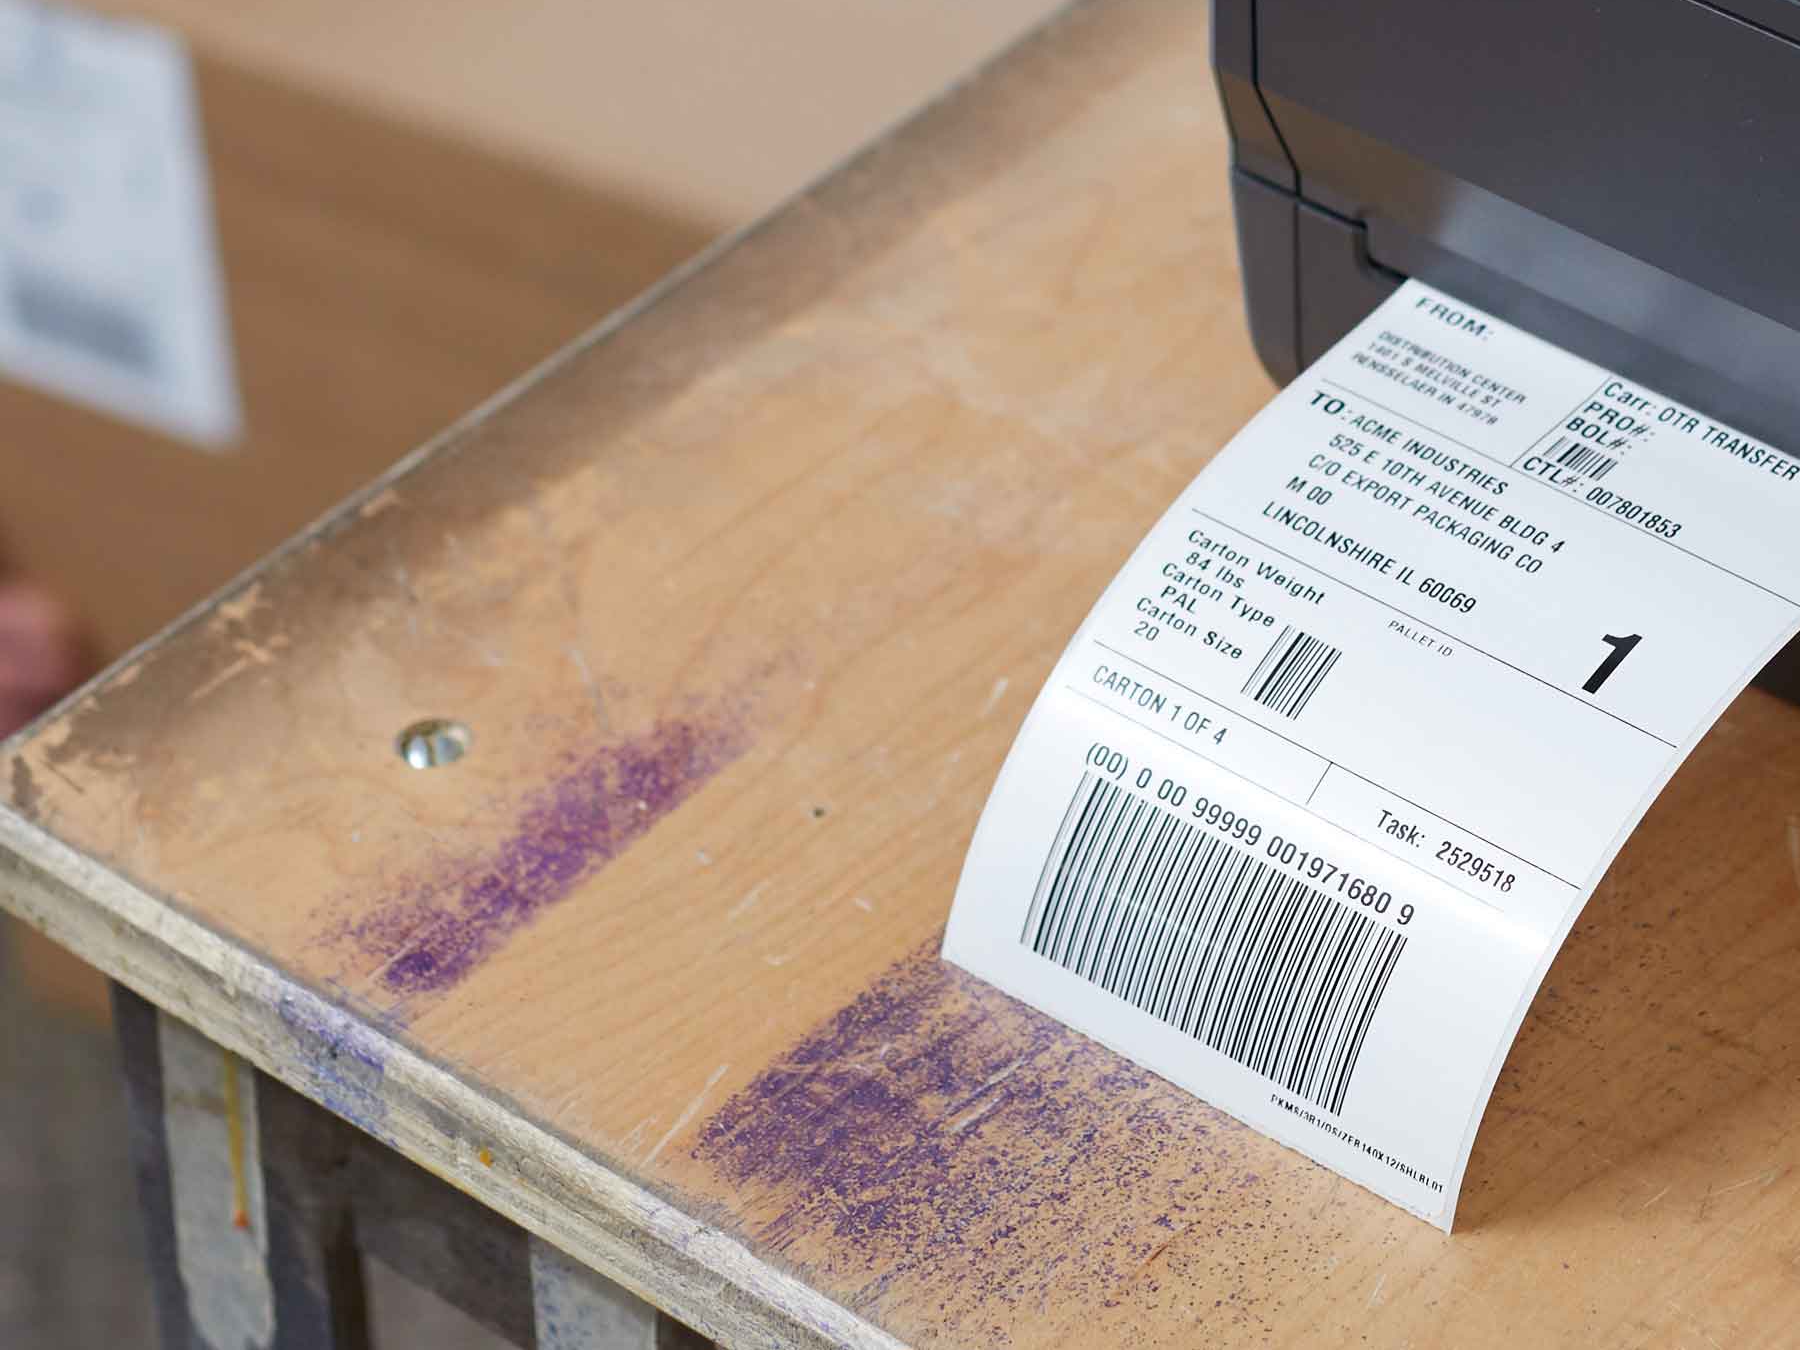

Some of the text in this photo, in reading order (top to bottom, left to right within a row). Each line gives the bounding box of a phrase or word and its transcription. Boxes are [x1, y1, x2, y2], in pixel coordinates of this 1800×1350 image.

[1416, 298, 1495, 340] FROM:
[1378, 331, 1526, 404] DISTRIBUTION CENTER
[1414, 364, 1479, 398] MELVILLE
[1480, 394, 1501, 408] ST
[1438, 392, 1456, 406] IN
[1309, 390, 1509, 496] TO: ACME INDUSTRIES
[1565, 417, 1633, 456] BOL#:
[1583, 401, 1656, 442] PRO#:
[1603, 381, 1800, 481] Carr: OTR TRANSFER
[1285, 476, 1333, 506] M 00
[1308, 453, 1543, 575] C/O EXPORT PACKAGING CO
[1328, 433, 1566, 554] 525 E 10TH AVENUE BLDG 4
[1522, 456, 1683, 539] CTL#: 007801853
[1186, 551, 1246, 589] 84 lbs
[1188, 529, 1326, 605] Carton Weight
[1262, 501, 1477, 614] LINCOLNSHIRE IL 60069
[1160, 585, 1199, 614] PAL
[1162, 562, 1276, 627] Carton Type
[1133, 620, 1160, 642] 20
[1136, 597, 1243, 659] Carton Size
[1387, 620, 1453, 657] PALLET ID
[1581, 633, 1643, 694] 1
[1093, 665, 1227, 745] CARTON 1 OF 4
[1086, 742, 1415, 925] (00) 0 00 99999 001971680 9
[1377, 808, 1516, 895] Task: 2529518
